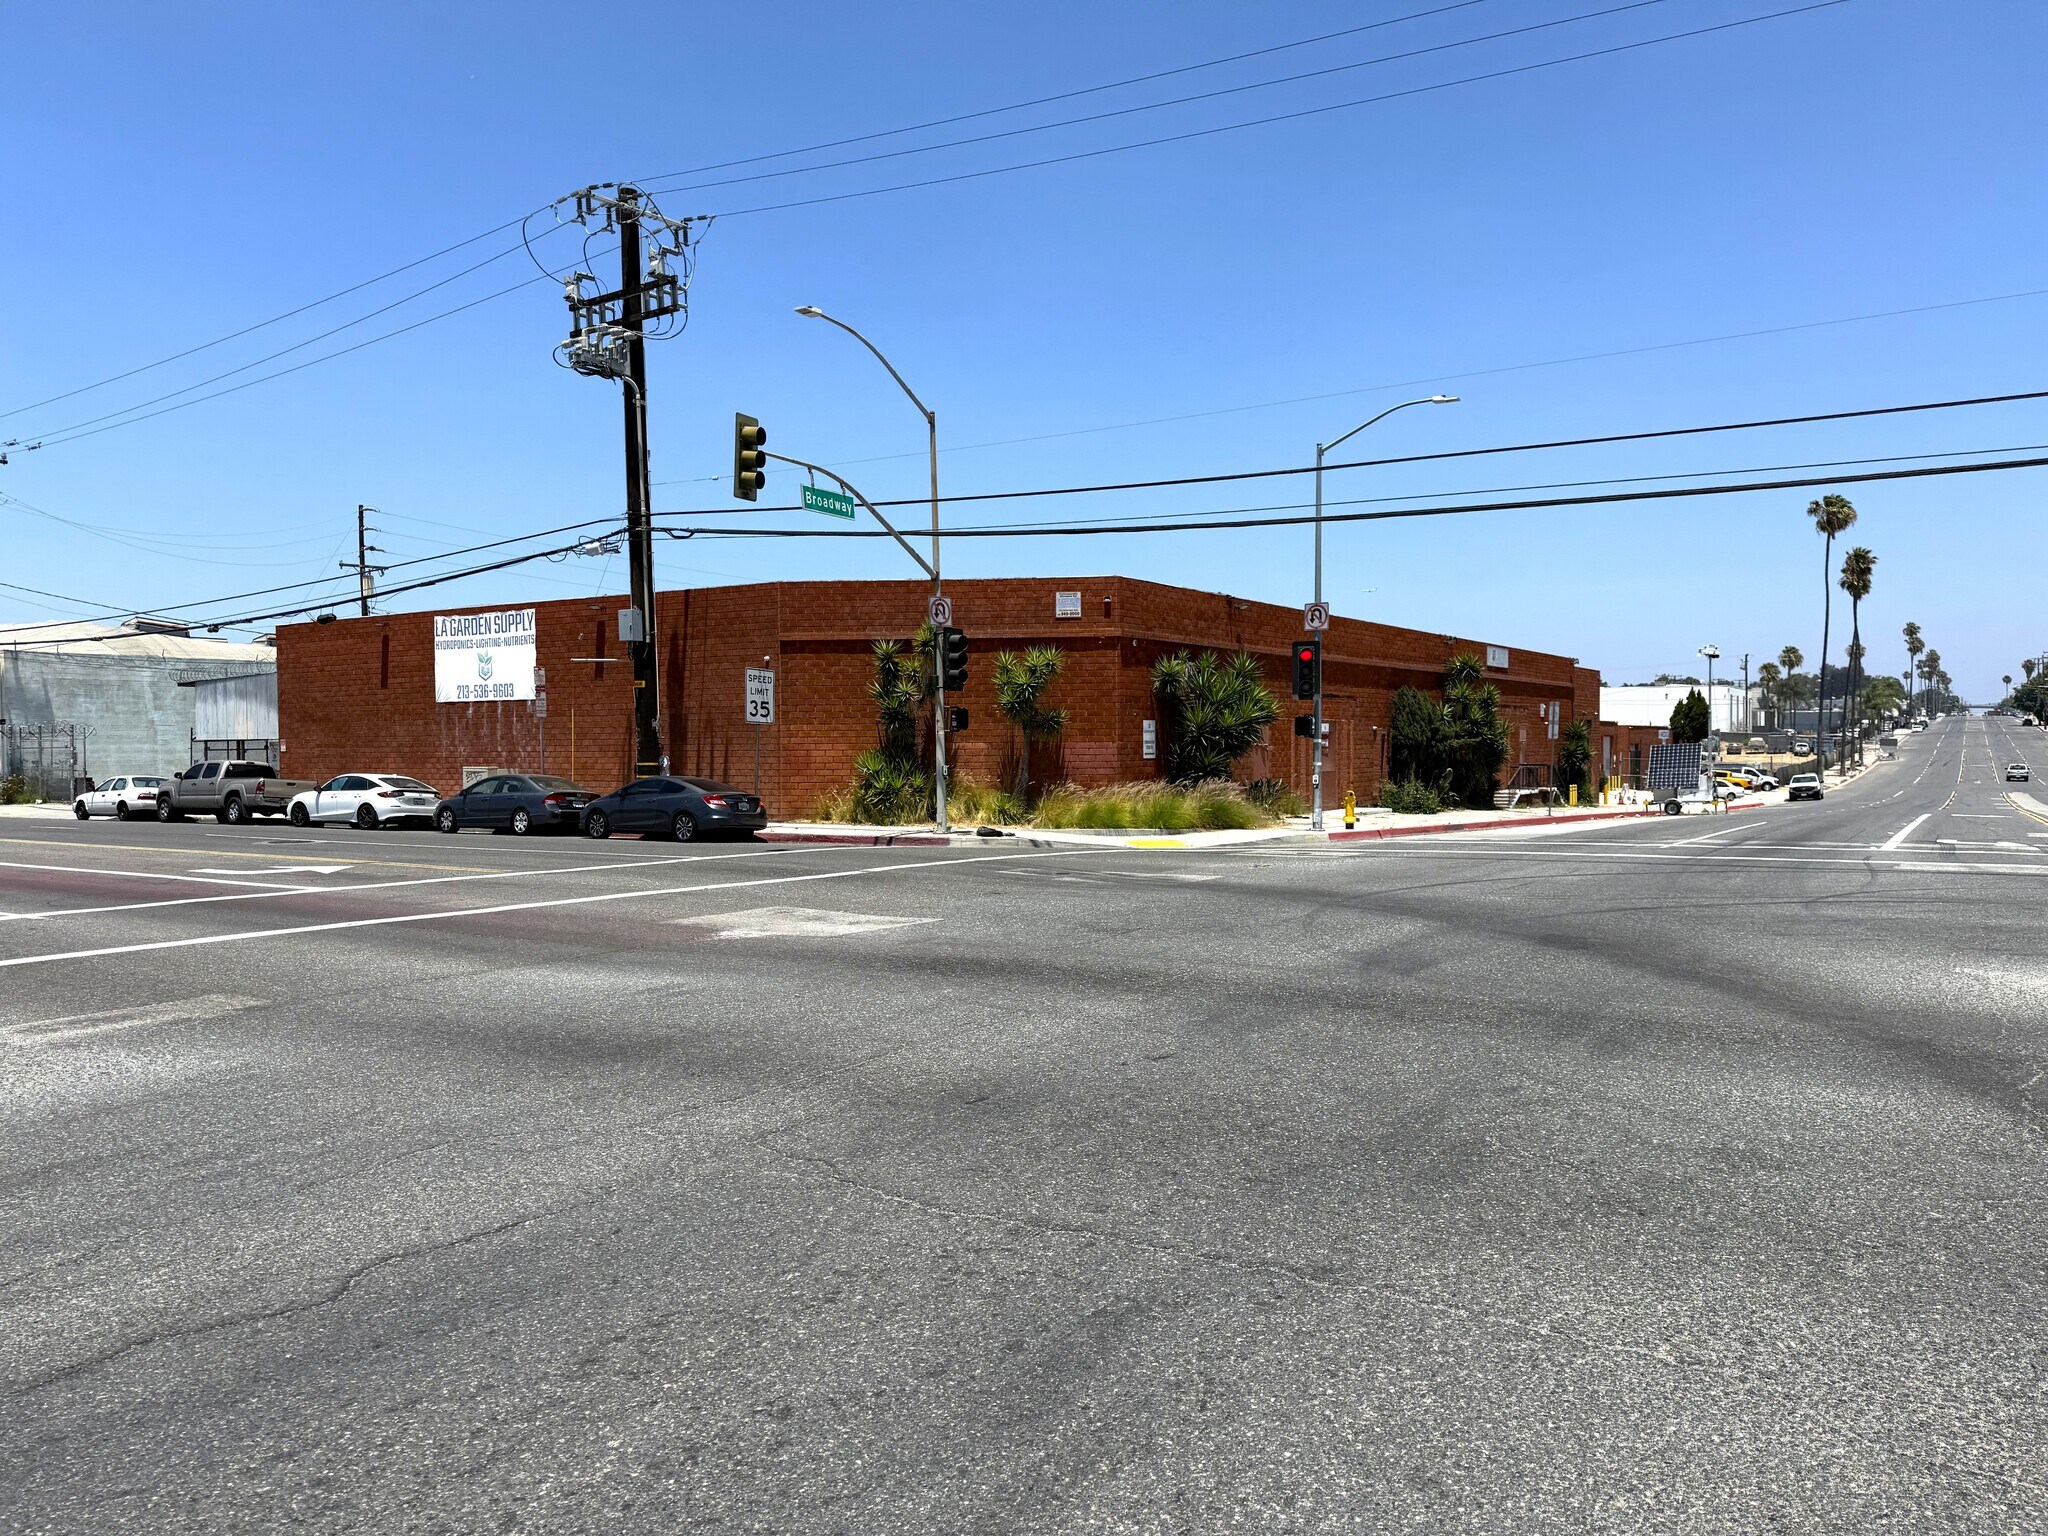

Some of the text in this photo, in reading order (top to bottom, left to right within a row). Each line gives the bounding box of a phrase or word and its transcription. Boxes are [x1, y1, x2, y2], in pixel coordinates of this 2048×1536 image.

[805, 491, 852, 516] Broadway
[435, 611, 534, 637] LA GARDEN SUPPLY
[748, 674, 773, 684] SPEED
[457, 683, 514, 699] 213-536-9603
[750, 687, 770, 697] LIMIT
[749, 700, 770, 718] 35
